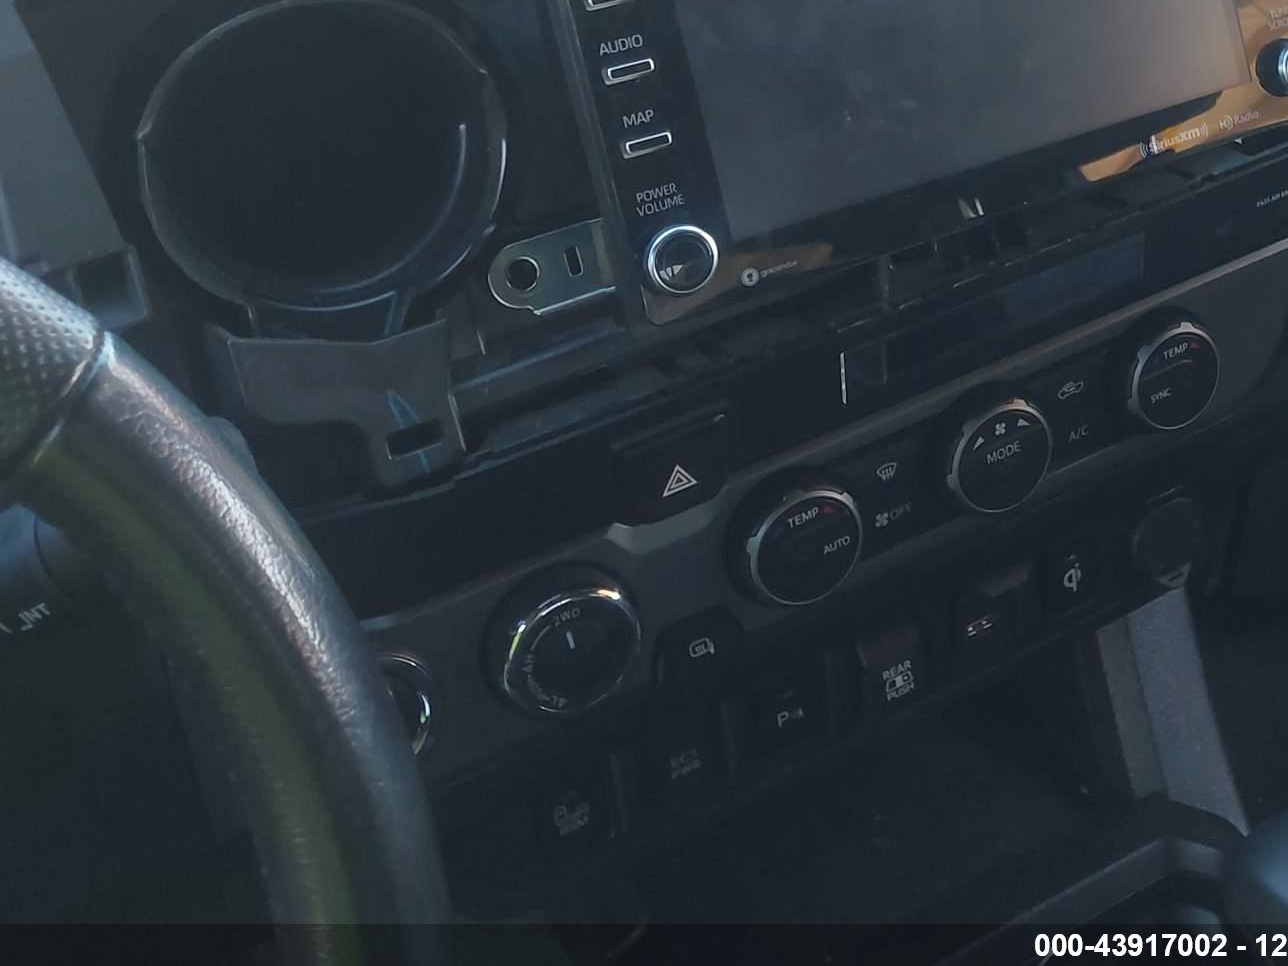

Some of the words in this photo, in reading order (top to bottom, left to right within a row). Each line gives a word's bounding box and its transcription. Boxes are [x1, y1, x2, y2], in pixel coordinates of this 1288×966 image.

[600, 34, 643, 57] AUDIO
[623, 109, 655, 129] MAP
[636, 183, 677, 203] POWER
[636, 194, 685, 217] VOLUME
[1163, 342, 1189, 361] TEMP
[986, 440, 1022, 466] MODE
[786, 507, 820, 529] TEMP
[824, 535, 850, 555] AUTO
[552, 607, 580, 626] 2WD
[882, 660, 911, 681] REAR
